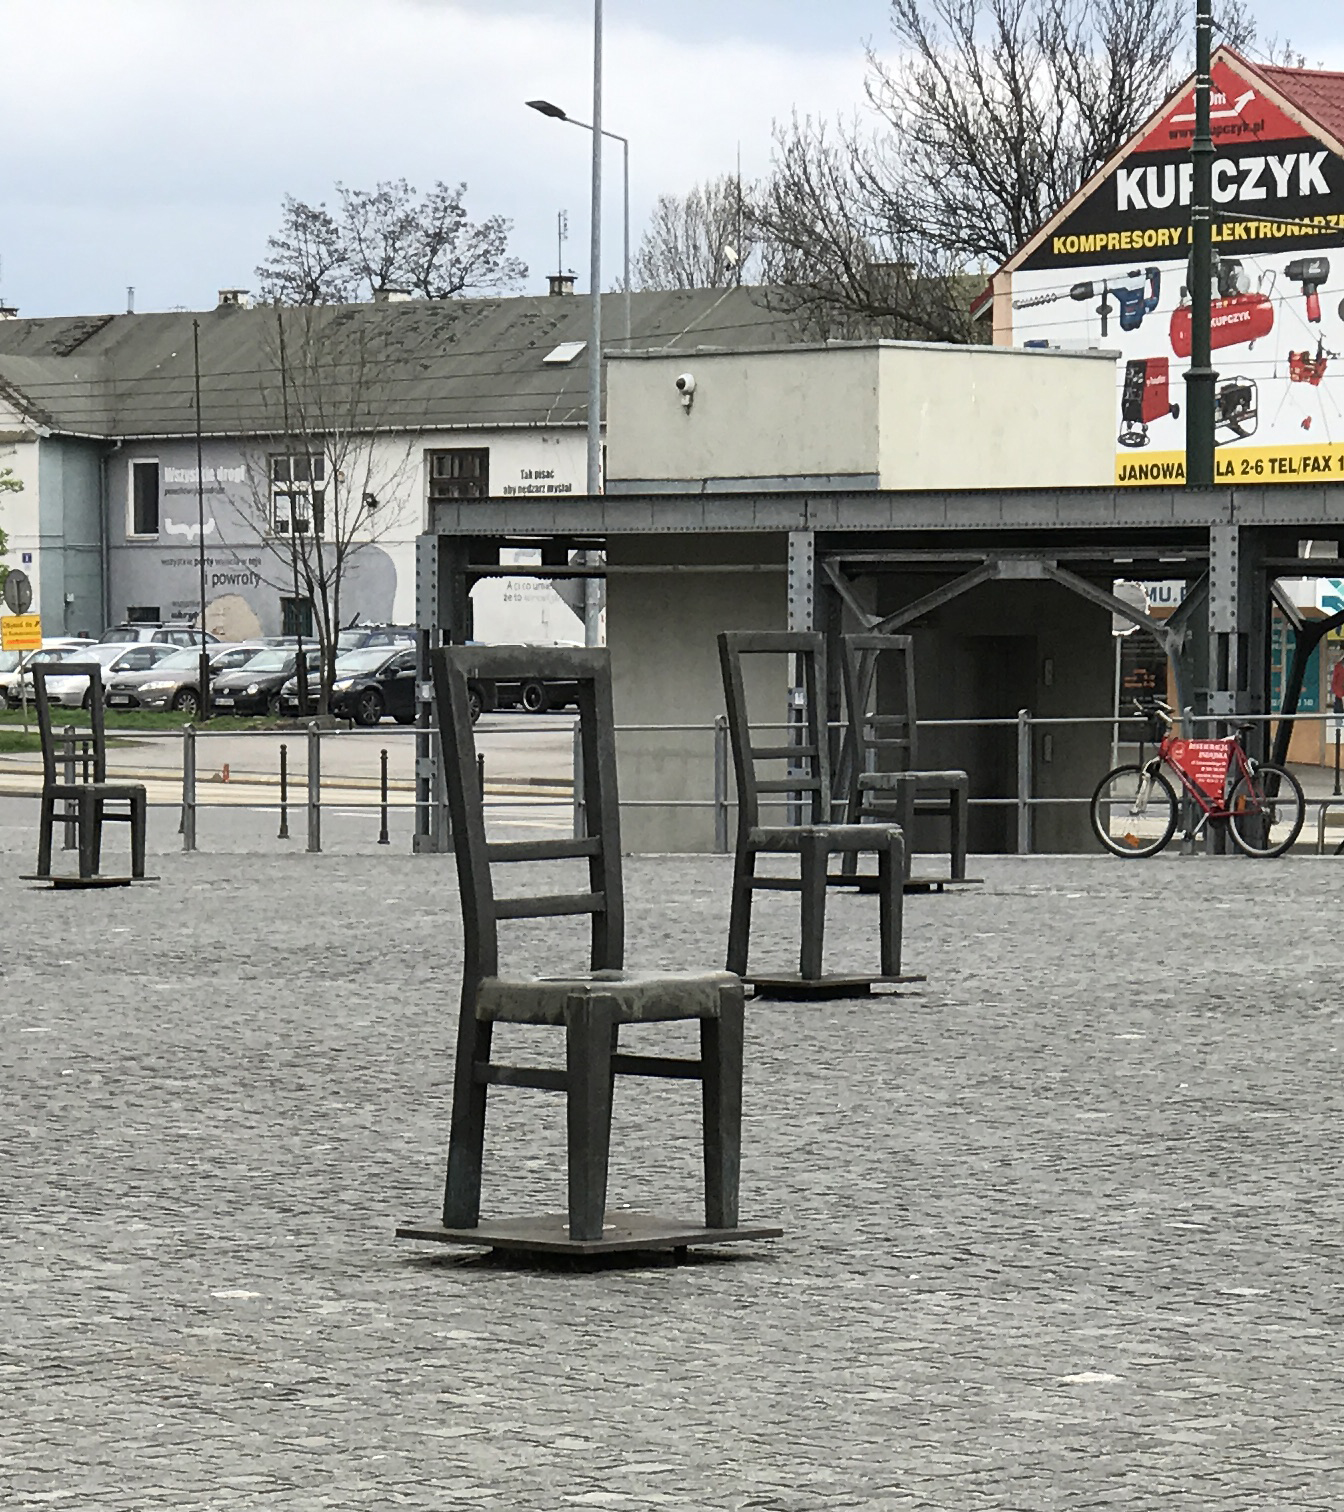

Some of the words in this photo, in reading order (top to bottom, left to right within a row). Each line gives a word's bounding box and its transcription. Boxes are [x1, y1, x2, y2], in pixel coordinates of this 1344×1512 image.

[1169, 118, 1264, 140] wwwupczyk.pl
[1054, 226, 1182, 254] KOMPRESORY
[1210, 310, 1251, 328] KUPCZYK
[1119, 463, 1186, 481] JANOWA
[1241, 458, 1264, 475] 2-6
[1269, 455, 1332, 475] TEL/FAX
